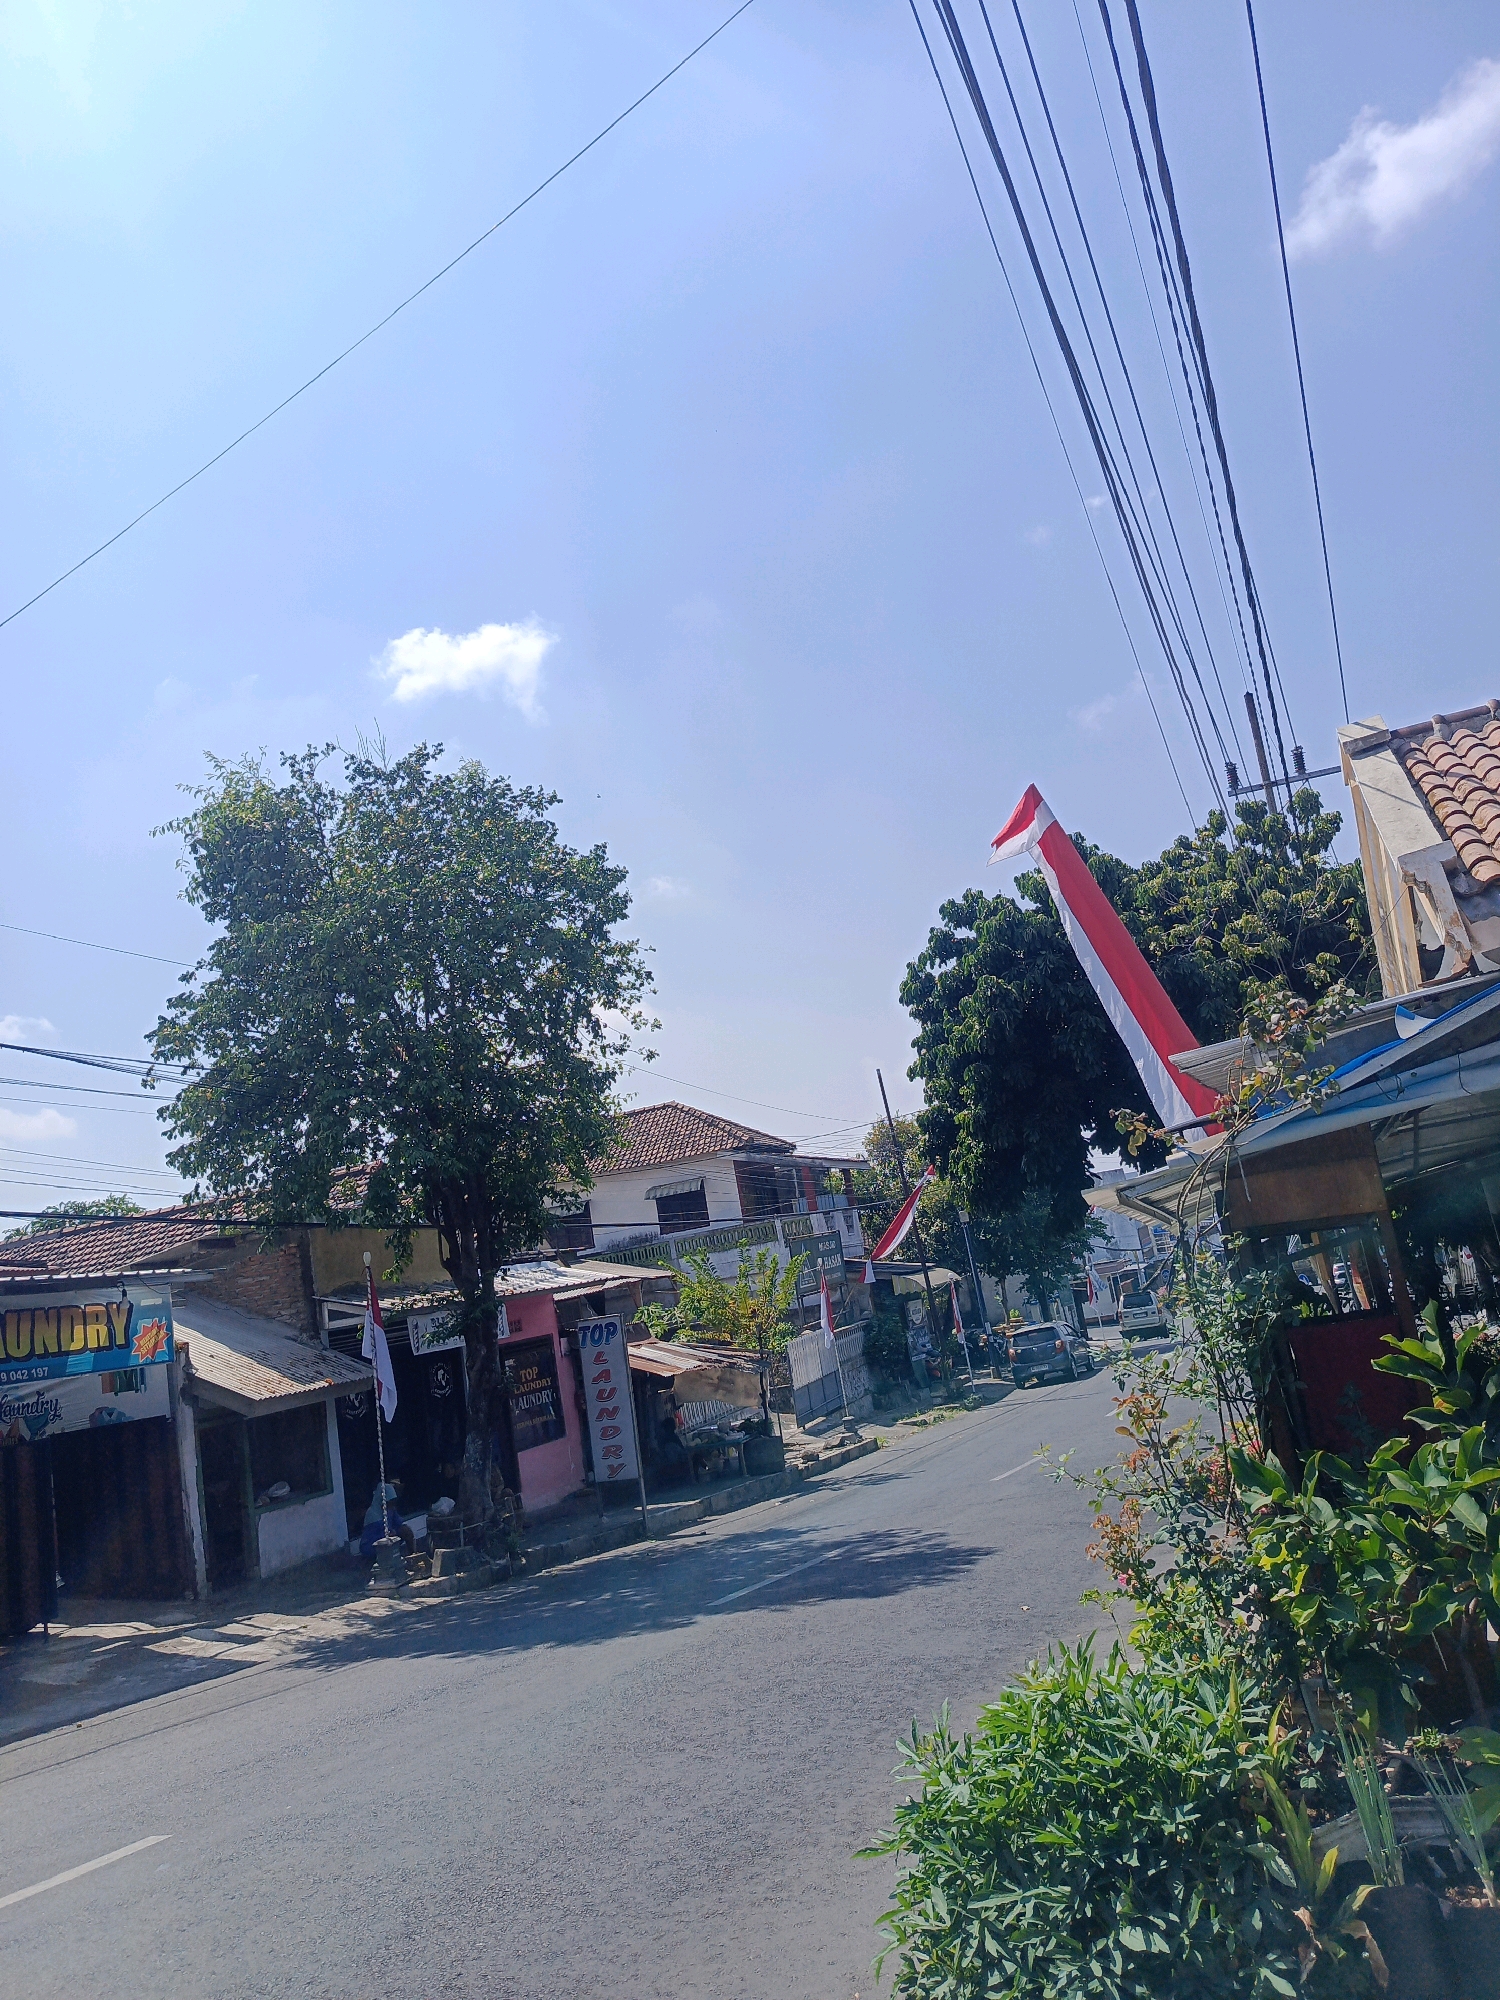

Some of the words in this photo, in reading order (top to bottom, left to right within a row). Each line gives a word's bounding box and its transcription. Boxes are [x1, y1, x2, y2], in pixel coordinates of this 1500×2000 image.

[0, 1302, 132, 1362] UNDRY
[578, 1322, 618, 1348] TOP
[10, 1370, 28, 1381] 042
[31, 1367, 49, 1378] 197
[520, 1366, 538, 1382] TOP
[514, 1377, 551, 1394] LAUNDRY
[512, 1389, 552, 1411] LAUNDRY
[591, 1351, 626, 1478] LAUNDRY
